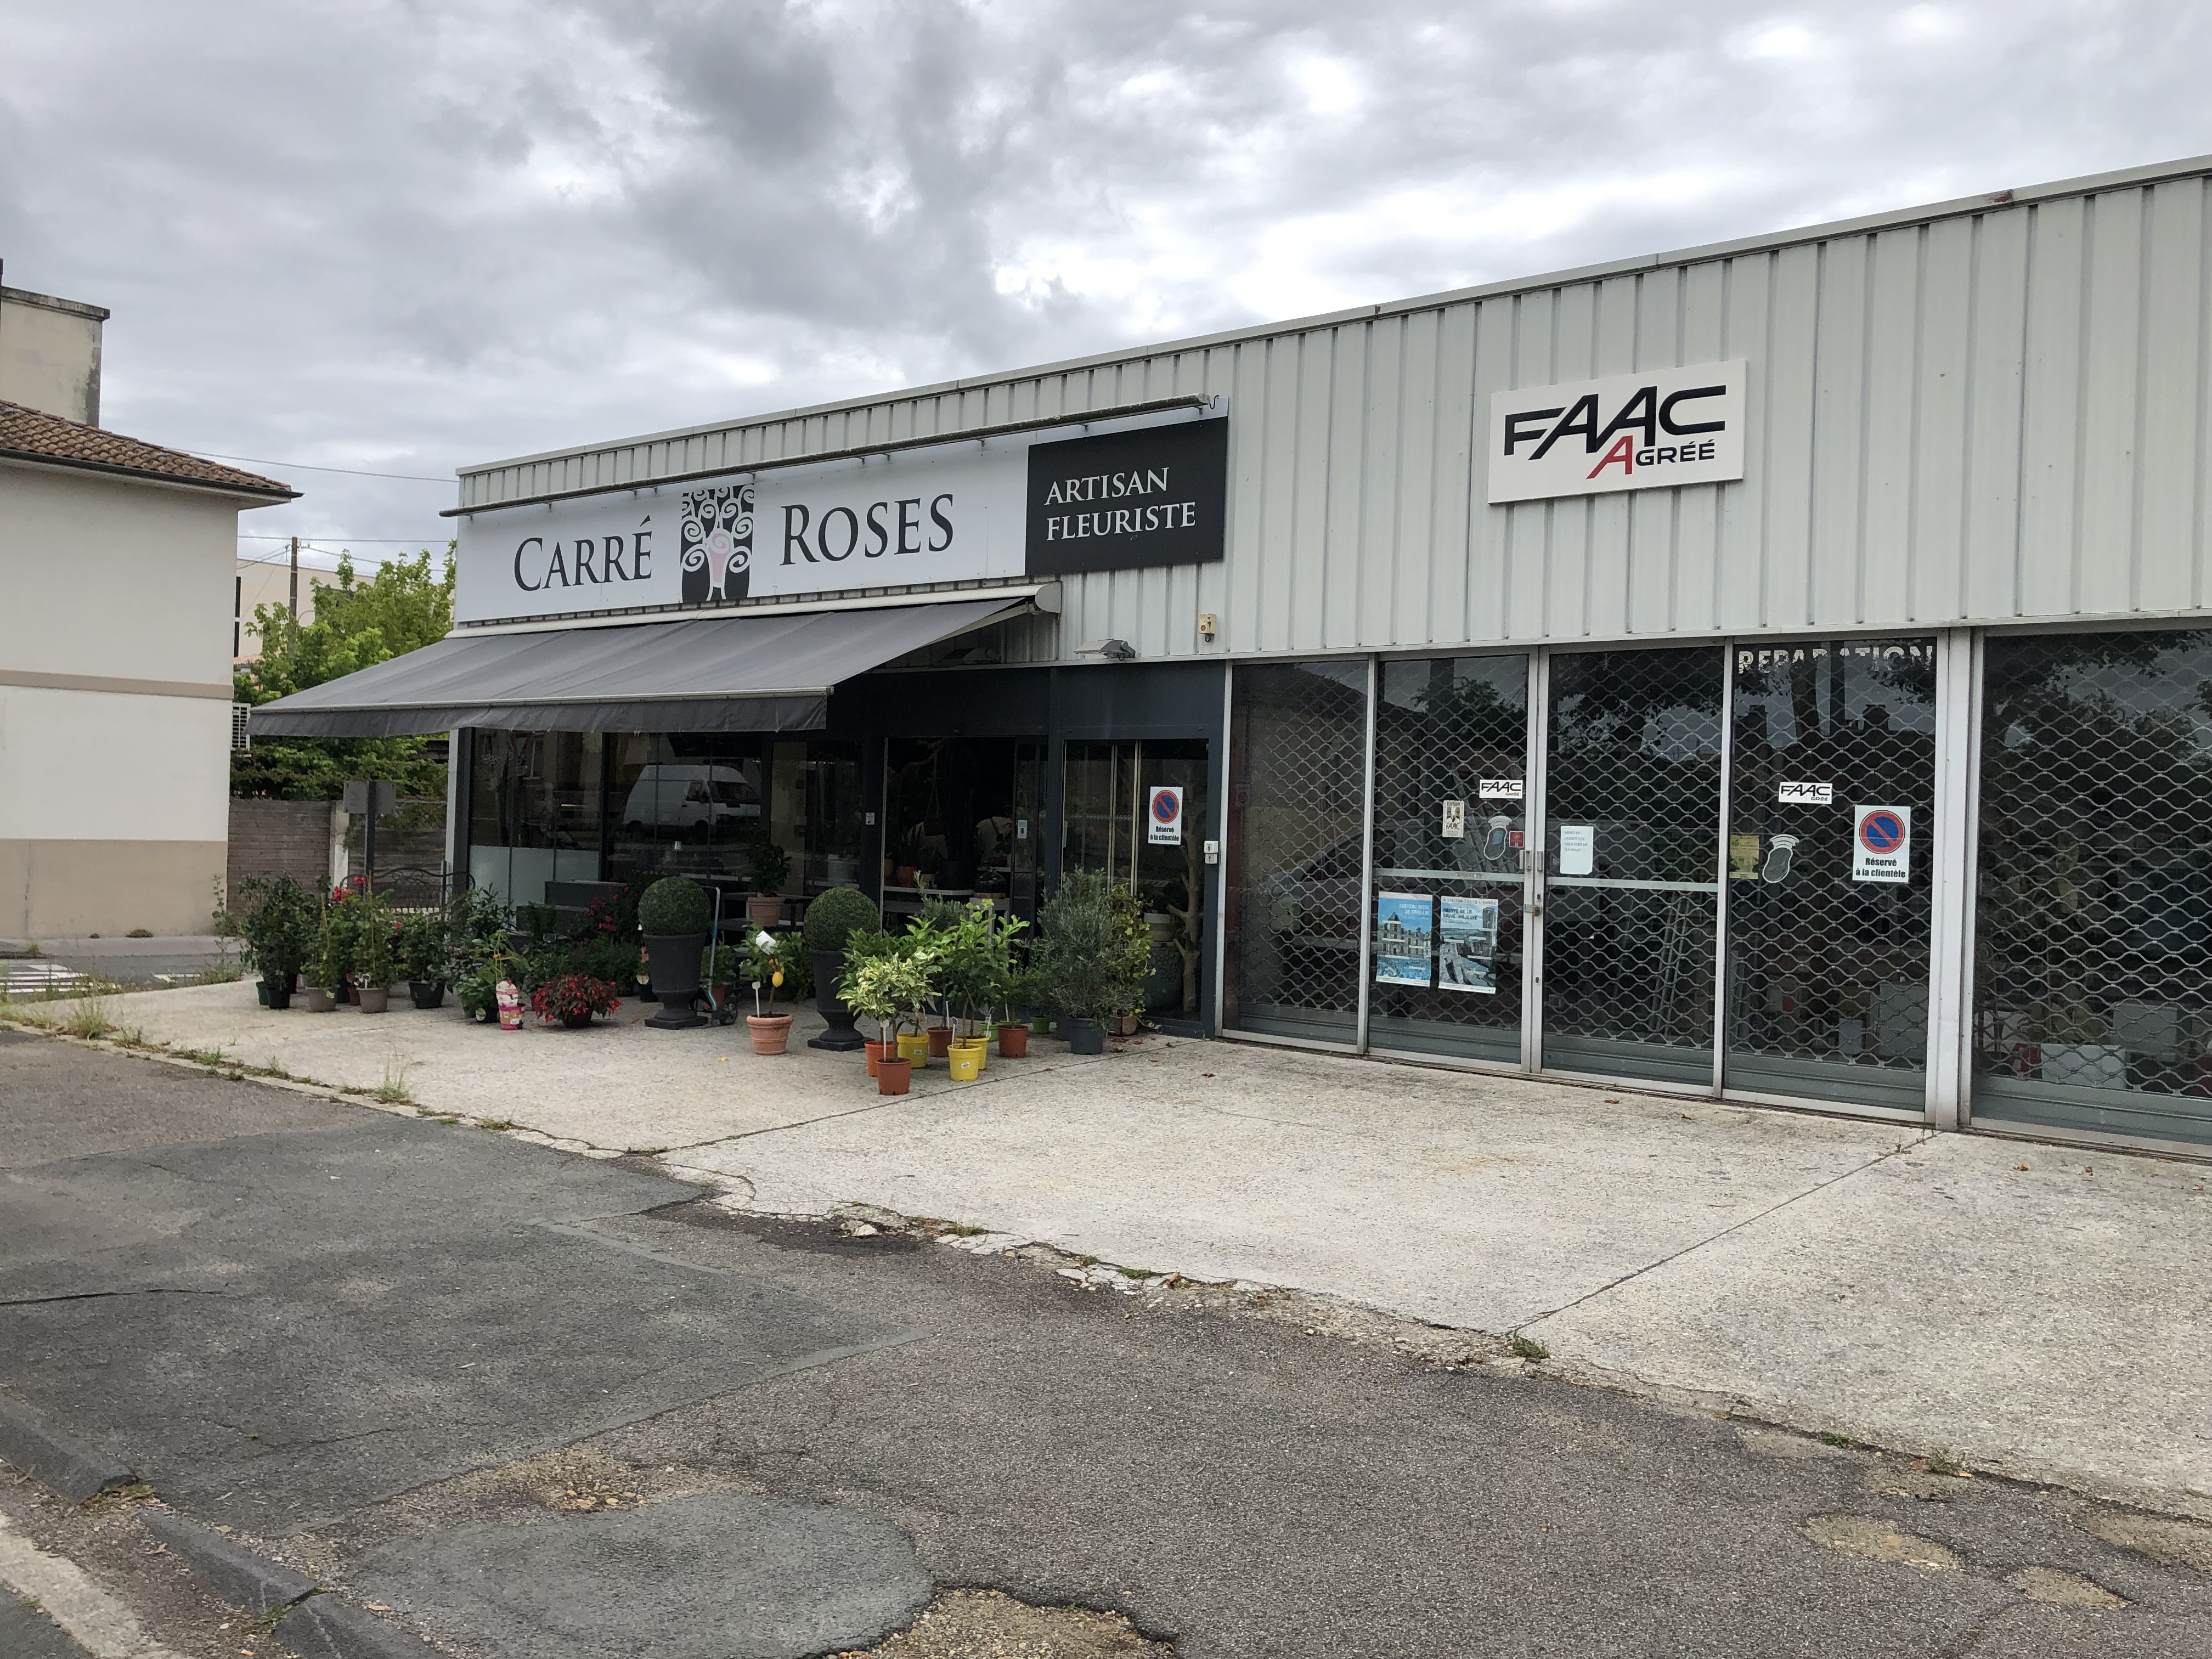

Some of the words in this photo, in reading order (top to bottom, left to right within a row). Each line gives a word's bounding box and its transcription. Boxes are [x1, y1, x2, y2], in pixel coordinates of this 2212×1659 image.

[1504, 384, 1726, 460] FAAC
[1585, 435, 1715, 479] AGRÉÉ
[1043, 467, 1170, 505] ARTISAN
[1046, 501, 1196, 541] FLEURISTE
[514, 514, 652, 591] CARRÉ
[780, 494, 953, 567] ROSES
[1481, 781, 1521, 793] FAAC
[1781, 783, 1831, 797] FAAC
[1855, 867, 1860, 876] à
[1862, 868, 1869, 876] la
[1871, 868, 1906, 878] clientèle
[1865, 857, 1897, 866] Réservé
